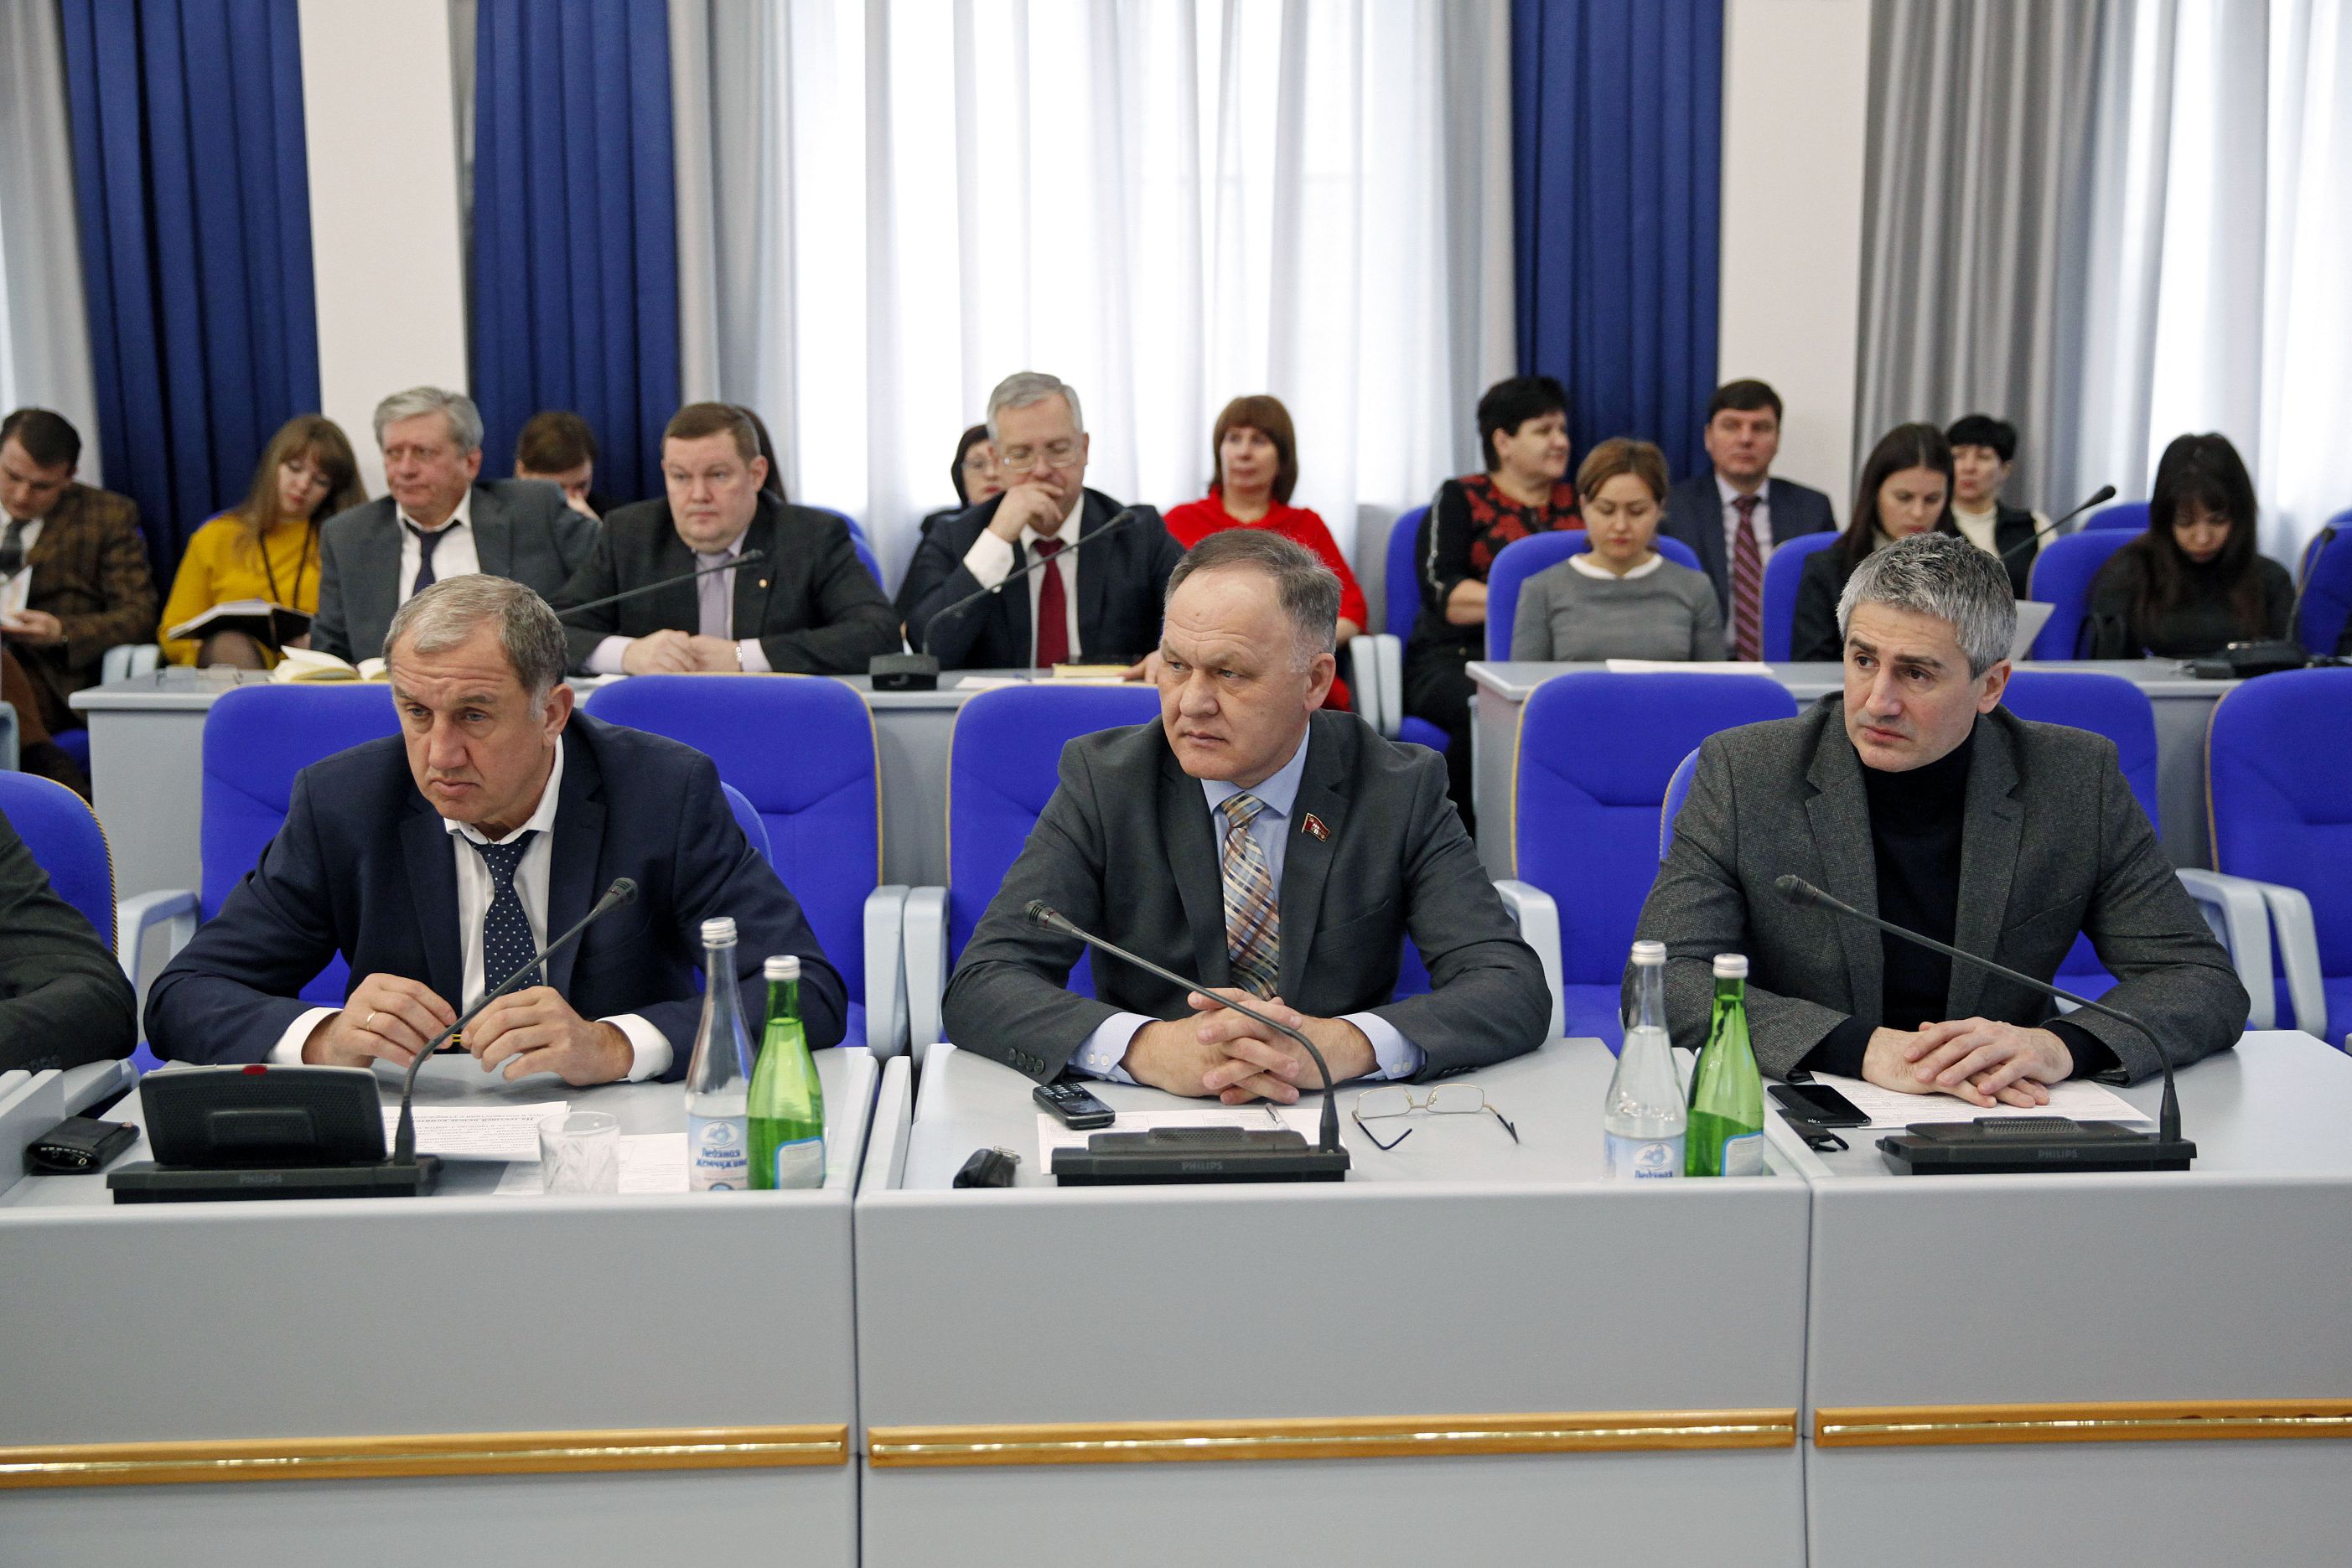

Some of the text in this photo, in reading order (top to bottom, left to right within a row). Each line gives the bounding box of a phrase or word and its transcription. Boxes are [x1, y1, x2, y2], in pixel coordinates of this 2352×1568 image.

[2038, 1149, 2078, 1158] PHILIPS
[1182, 1162, 1222, 1171] PHILIPS
[239, 1174, 282, 1183] PHILIPS
